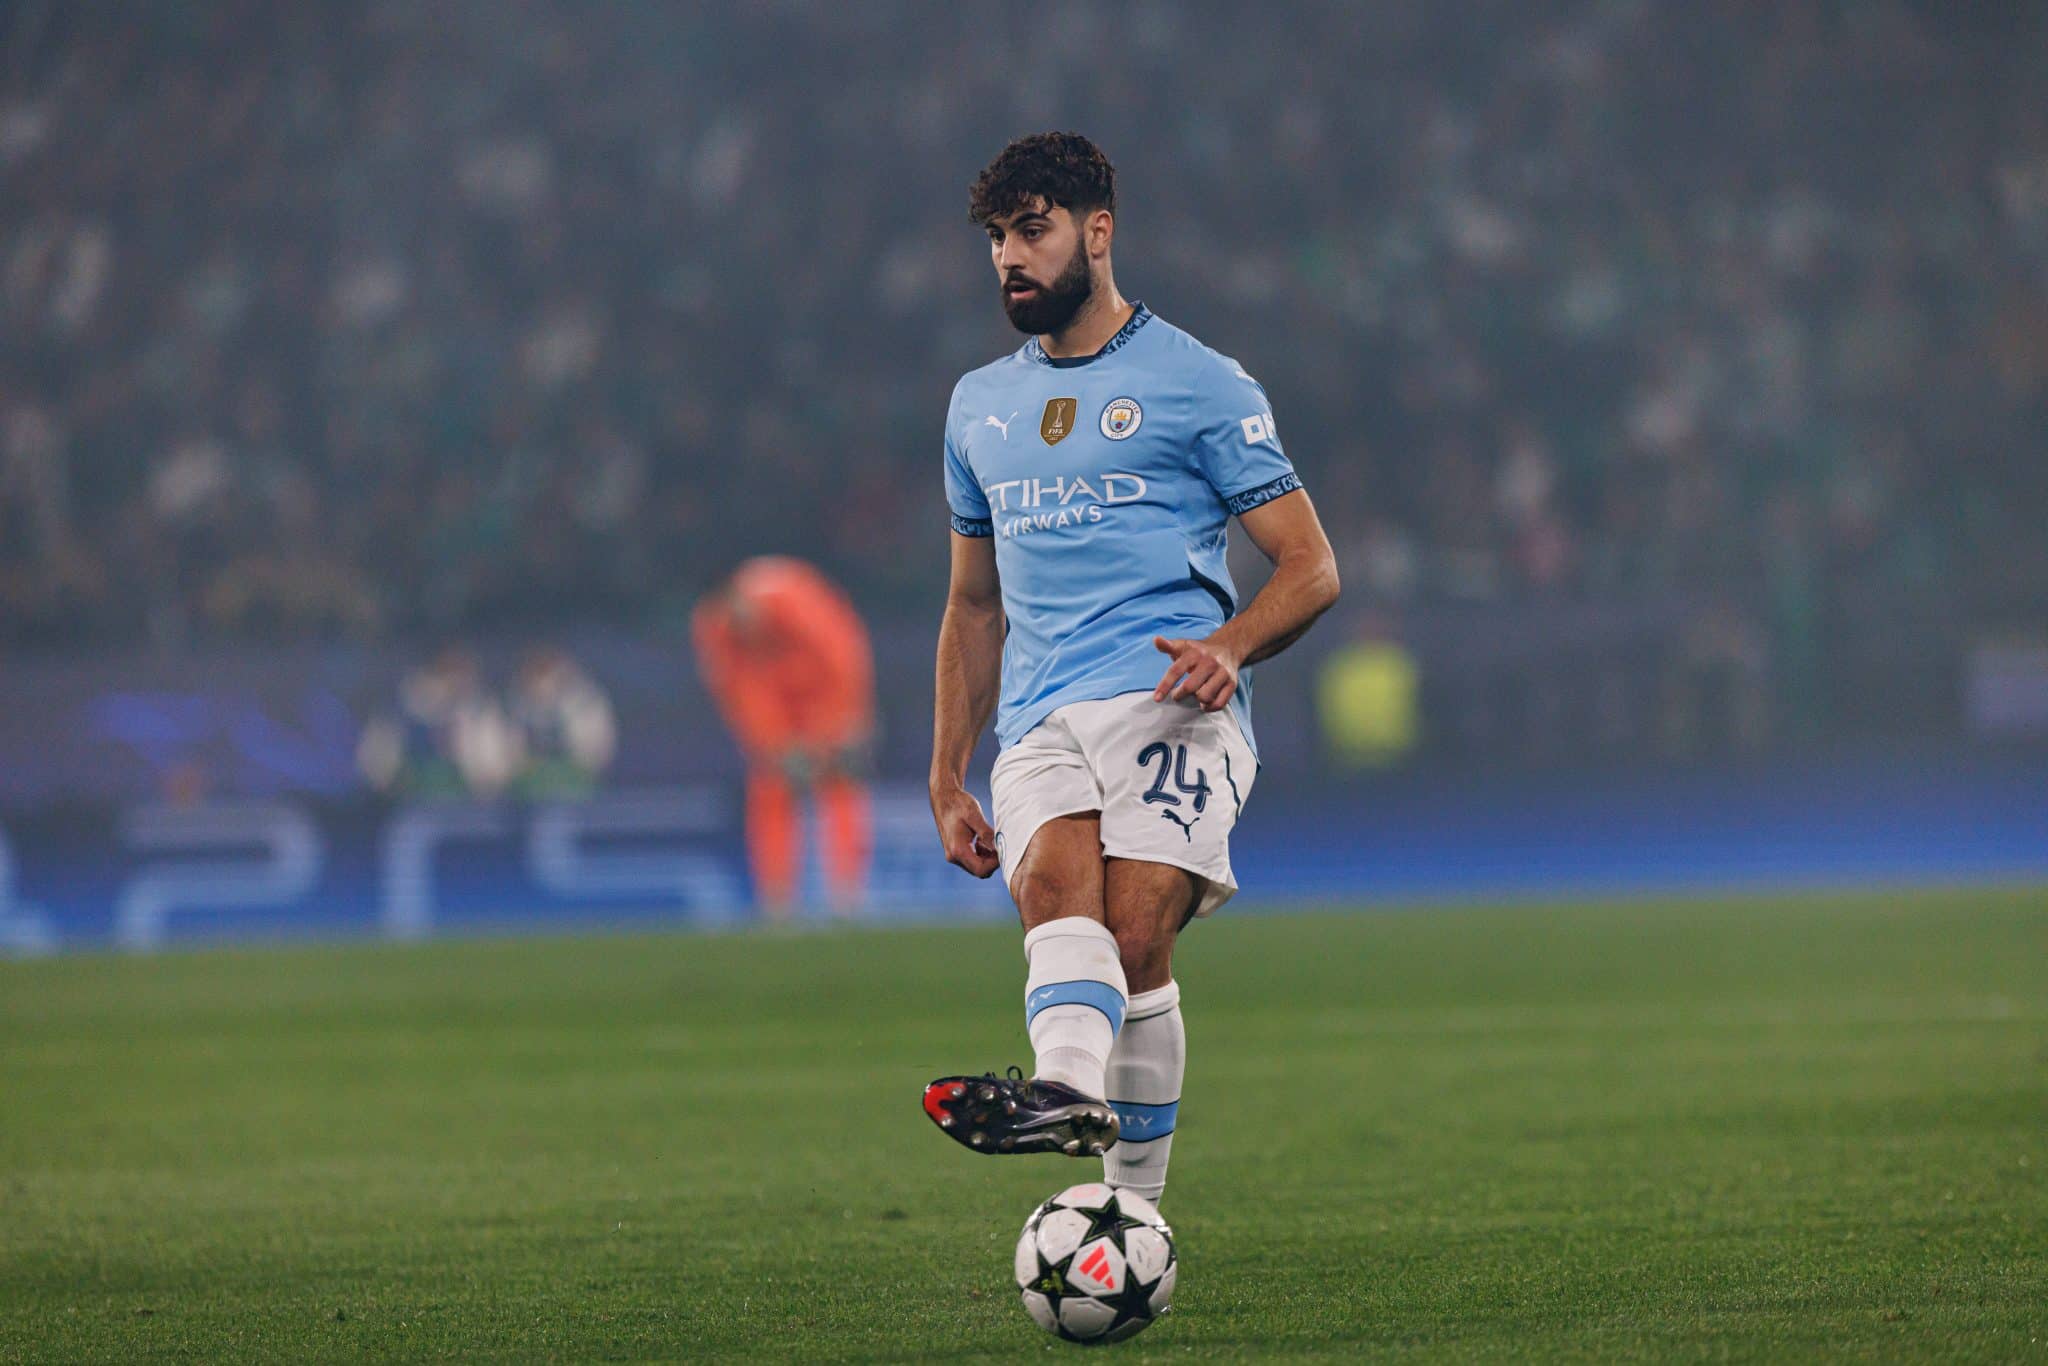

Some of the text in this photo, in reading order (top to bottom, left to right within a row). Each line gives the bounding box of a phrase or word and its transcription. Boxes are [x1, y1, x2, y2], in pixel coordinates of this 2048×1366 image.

[1105, 399, 1140, 414] MANCHESTER
[1241, 413, 1277, 445] OK
[1002, 505, 1102, 538] AIRWAYS
[1137, 742, 1212, 813] 24
